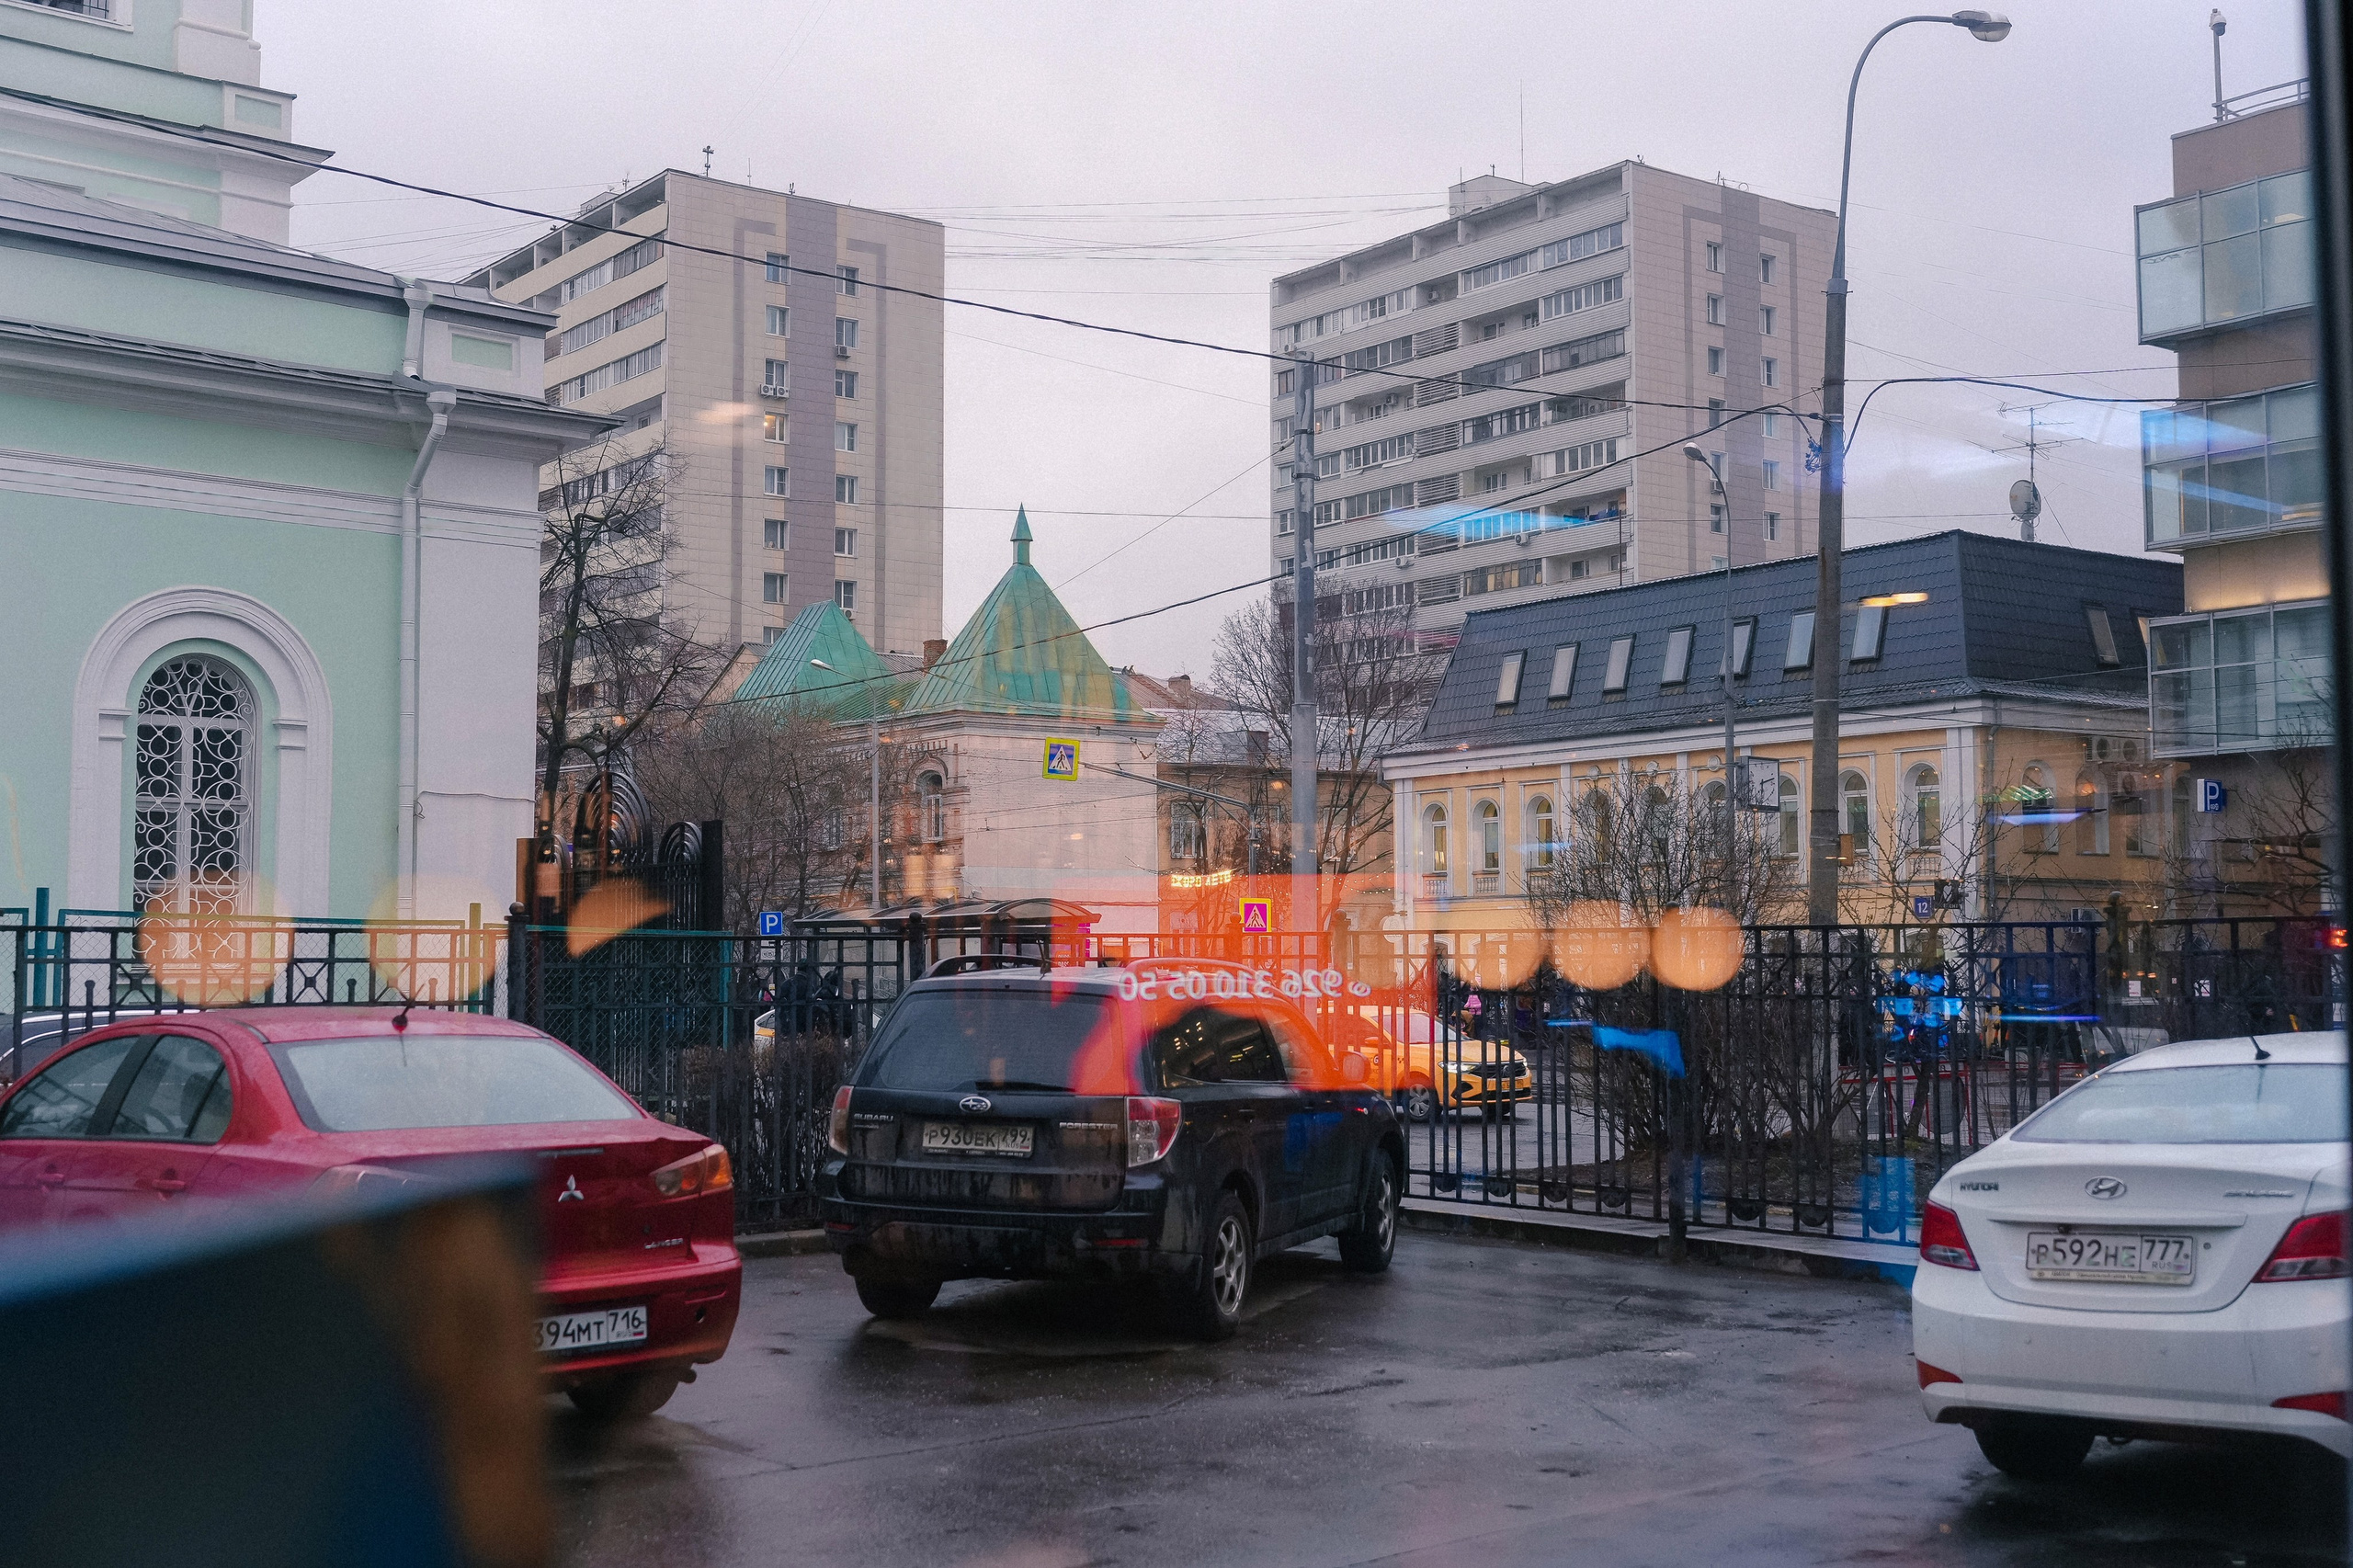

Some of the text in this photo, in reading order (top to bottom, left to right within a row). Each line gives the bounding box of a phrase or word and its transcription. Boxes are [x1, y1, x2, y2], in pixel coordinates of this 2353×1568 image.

[2207, 782, 2220, 811] P
[1917, 903, 1928, 914] 12
[766, 915, 779, 933] P
[854, 1113, 894, 1121] SUBARU
[1001, 1128, 1028, 1143] 799
[1960, 1182, 2000, 1191] HYUNDAI
[644, 1238, 684, 1249] LANCER
[2144, 1239, 2185, 1261] 777
[2152, 1261, 2172, 1269] RUS
[609, 1310, 642, 1332] 716
